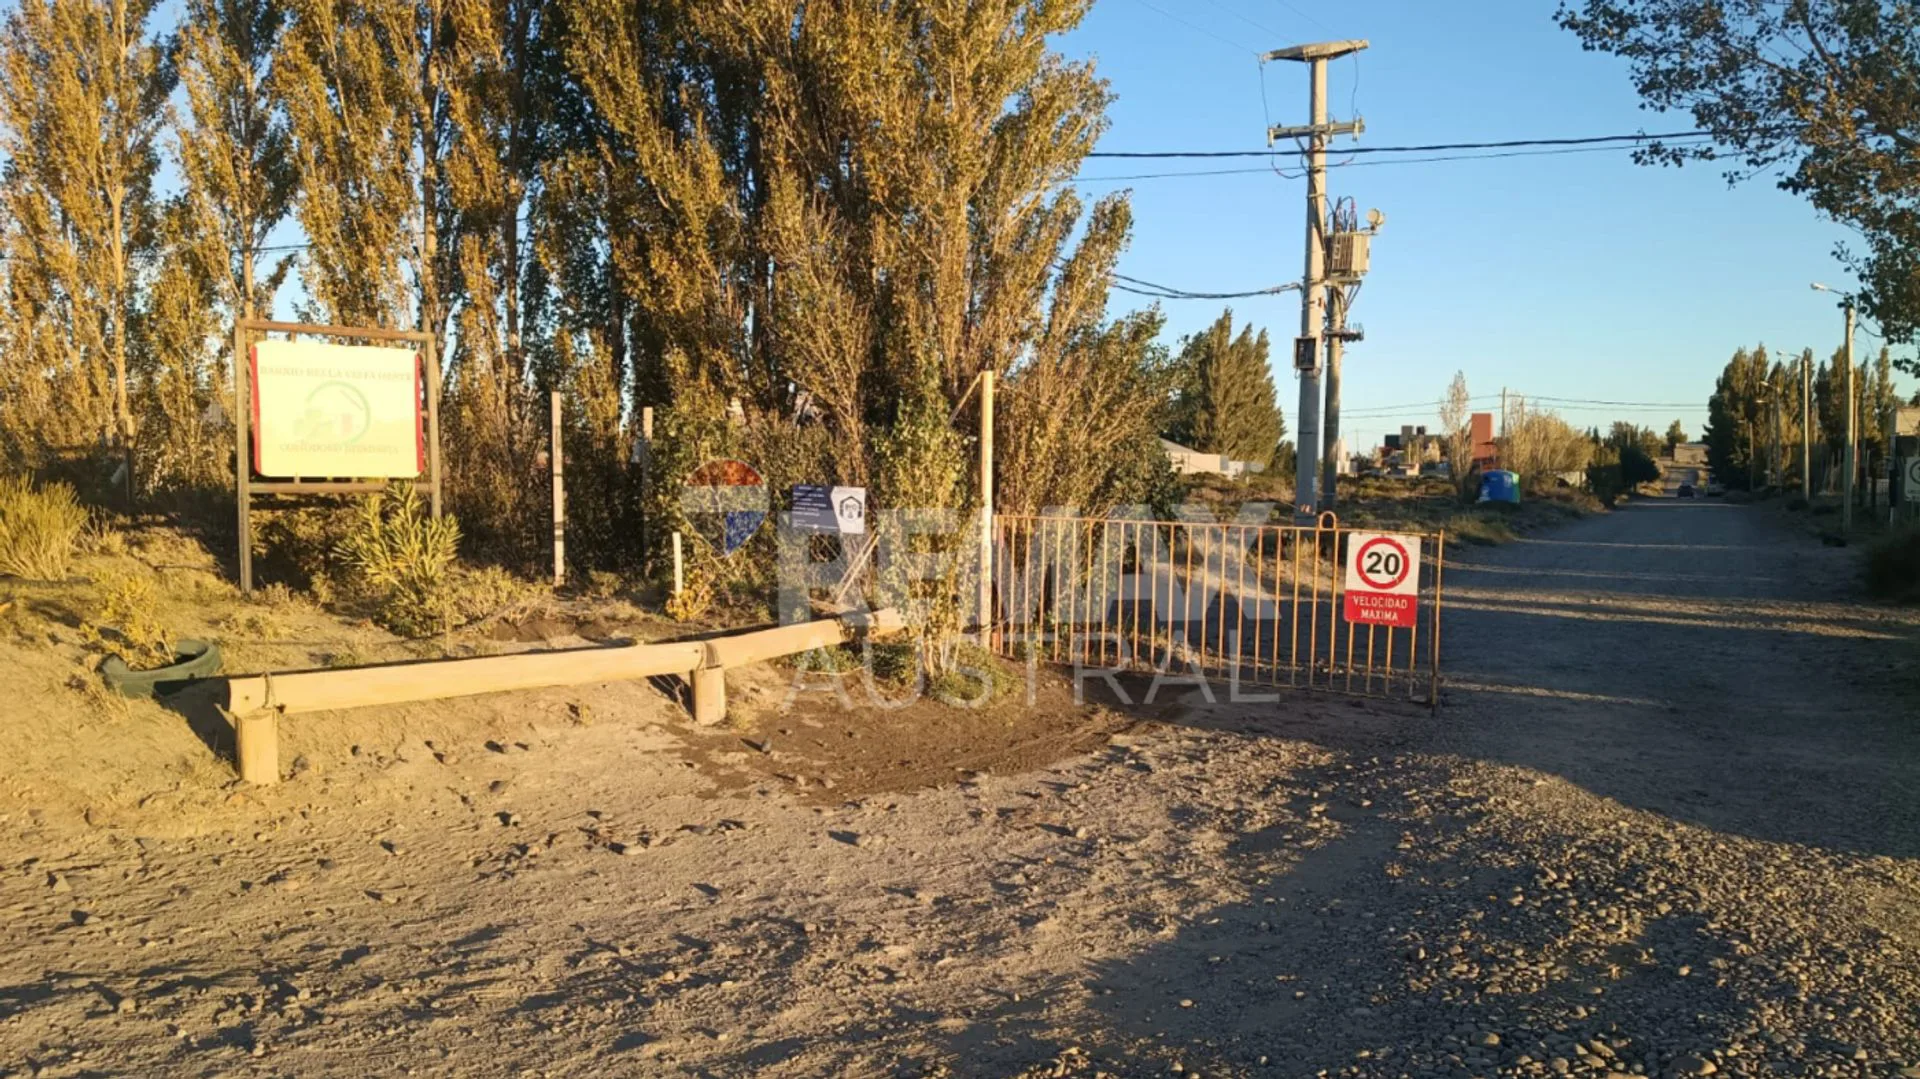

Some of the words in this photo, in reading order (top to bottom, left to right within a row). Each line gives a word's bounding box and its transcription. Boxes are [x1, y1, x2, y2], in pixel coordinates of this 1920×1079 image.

[1366, 551, 1400, 576] 20
[1352, 595, 1408, 609] VELOCIDAD
[1360, 609, 1398, 621] MAXIMA
